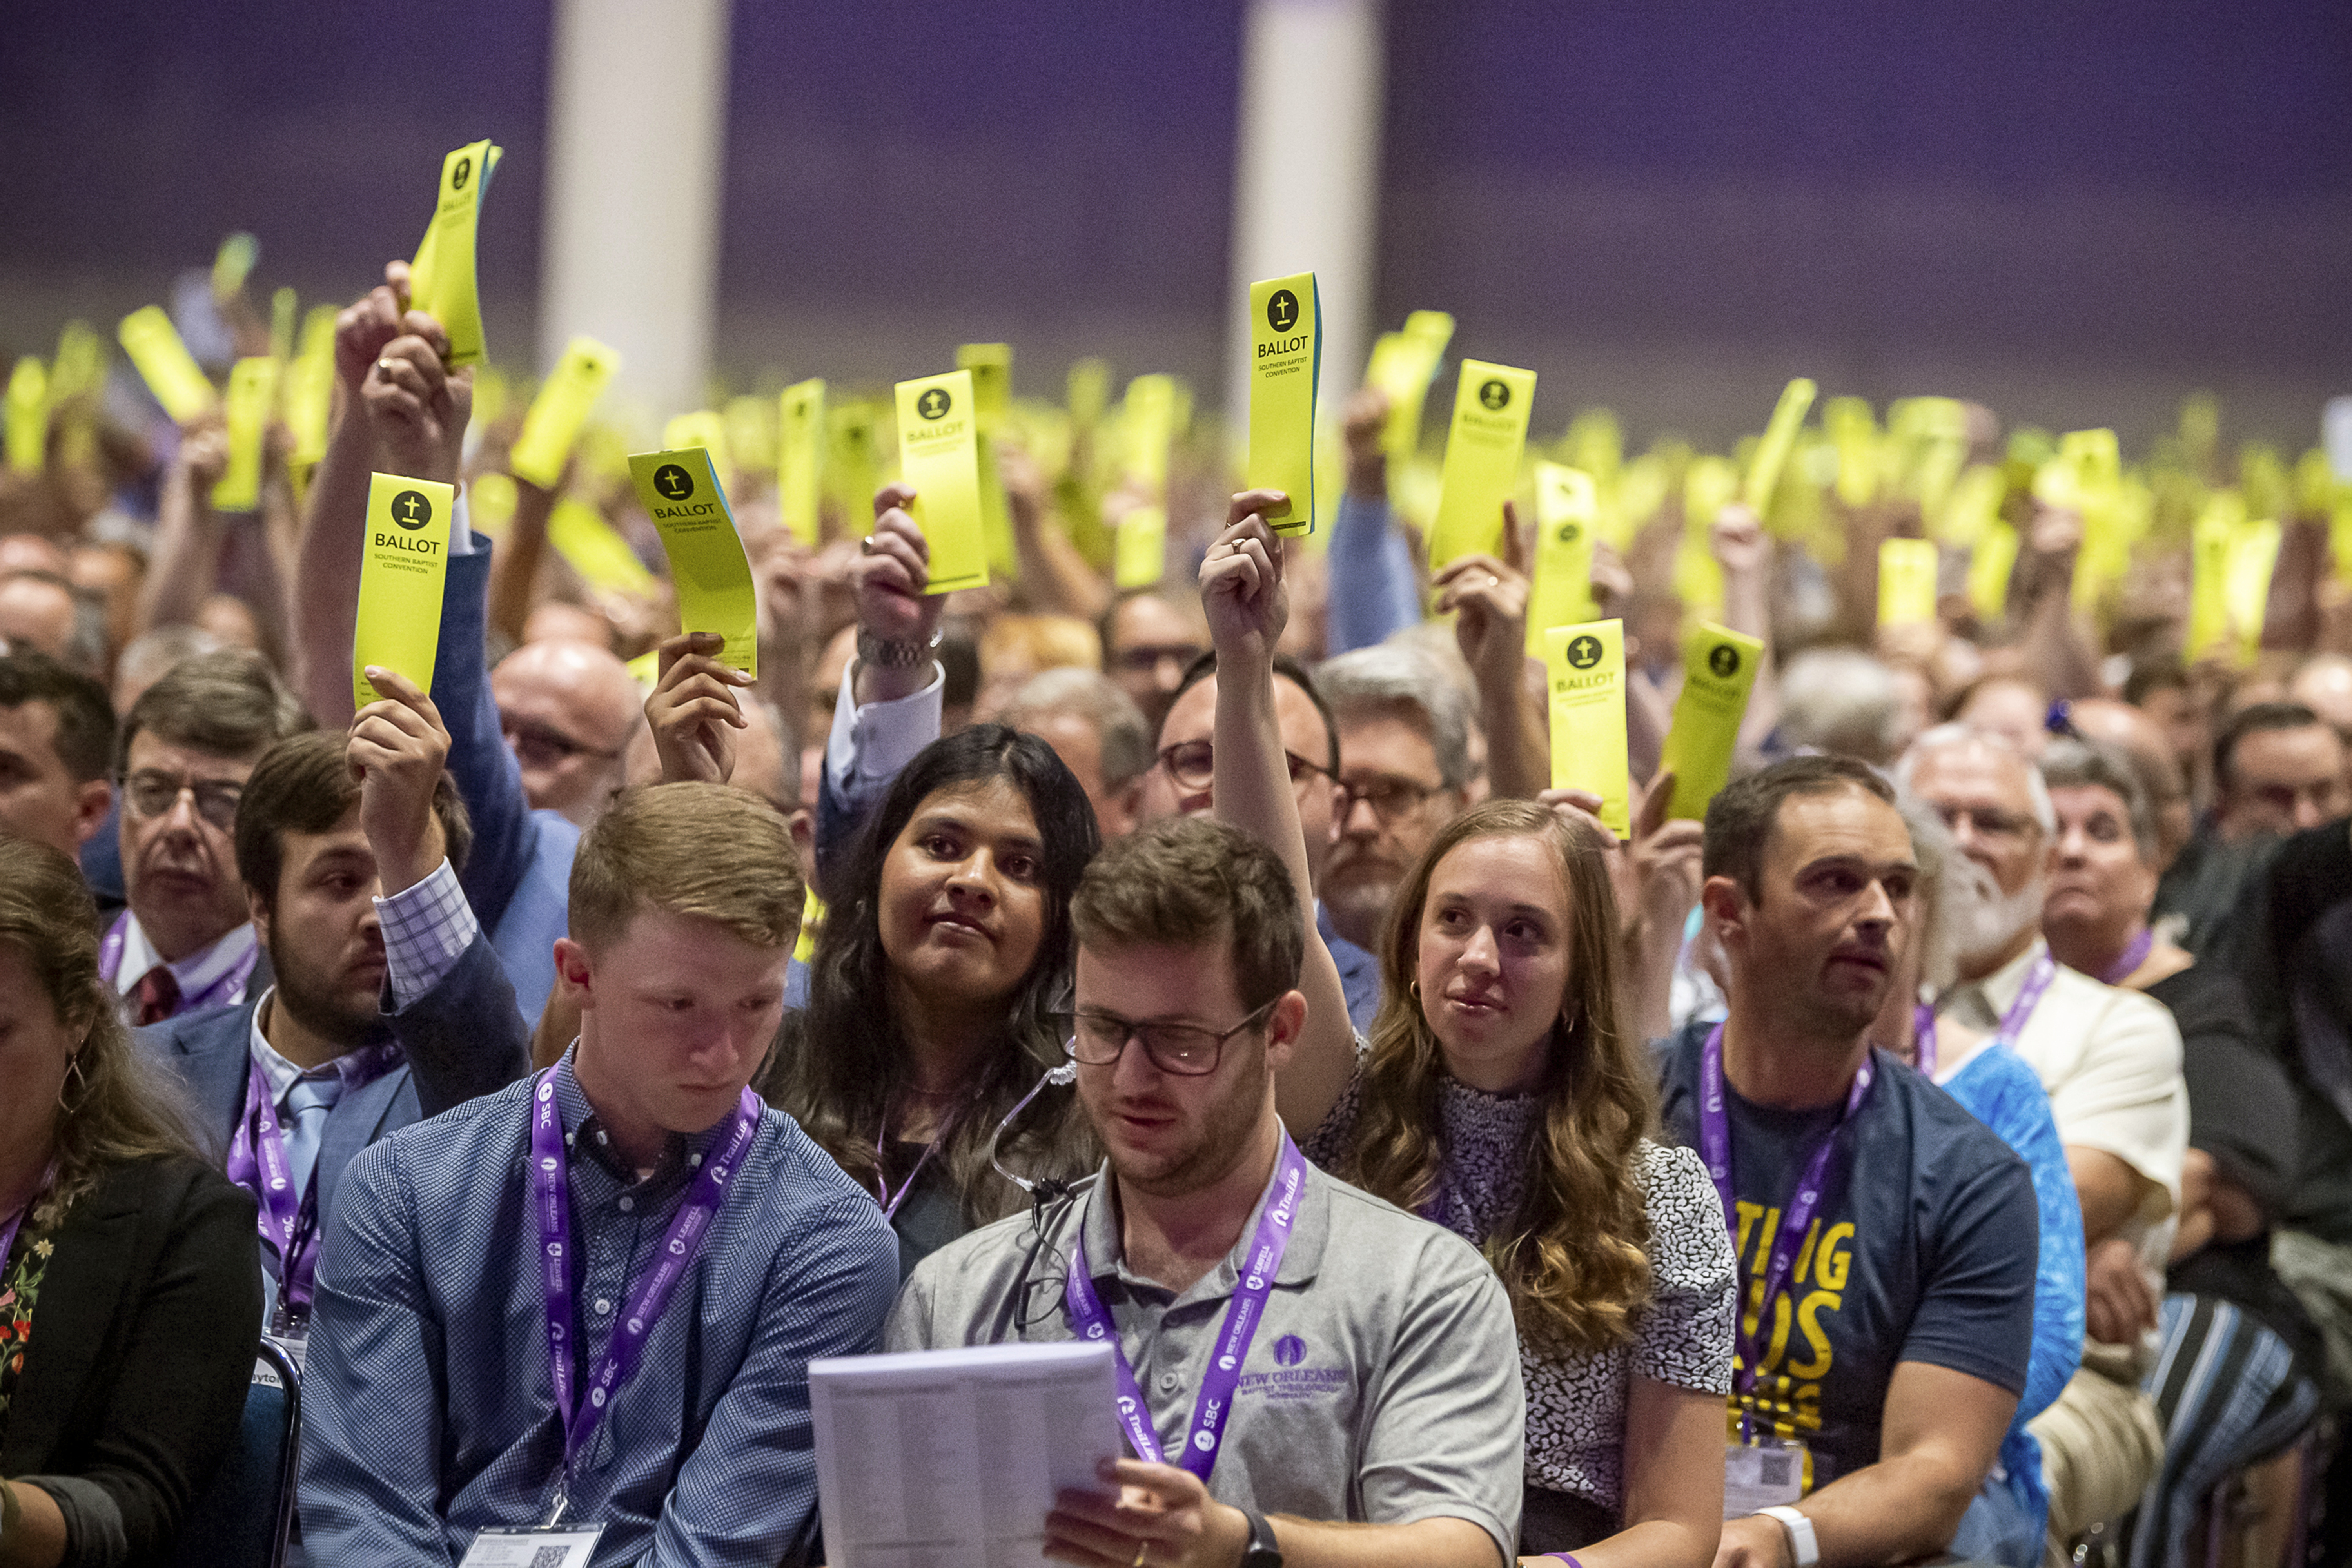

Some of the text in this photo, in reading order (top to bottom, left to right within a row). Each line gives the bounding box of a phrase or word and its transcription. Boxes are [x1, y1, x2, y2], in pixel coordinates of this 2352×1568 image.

[1258, 335, 1308, 358] BALLOT
[1258, 356, 1307, 371] SOUTHERN BAPTIST
[1265, 367, 1300, 378] CONVENTION
[907, 420, 966, 444] BALLOT
[654, 503, 714, 519] BALLOT
[375, 533, 441, 555] BALLOT
[374, 554, 438, 568] SOUTHERN BAPTIST
[383, 562, 428, 574] CONVENTION
[1556, 672, 1614, 693] BALLOT
[541, 1103, 552, 1129] SBC
[719, 1118, 749, 1165] Trail Life
[1279, 1167, 1300, 1211] Trail Life
[548, 1172, 559, 1233] NEW ORLEANS
[1736, 1200, 1855, 1291] TIG
[1252, 1246, 1270, 1276] LEAVELL
[637, 1261, 670, 1318] NEW ORLEANS
[1225, 1298, 1252, 1354] NEW ORLEANS
[601, 1358, 618, 1387] SBC
[1272, 1369, 1347, 1383] ORLEANS
[1203, 1399, 1221, 1429] SBC
[1127, 1414, 1151, 1446] Trail
